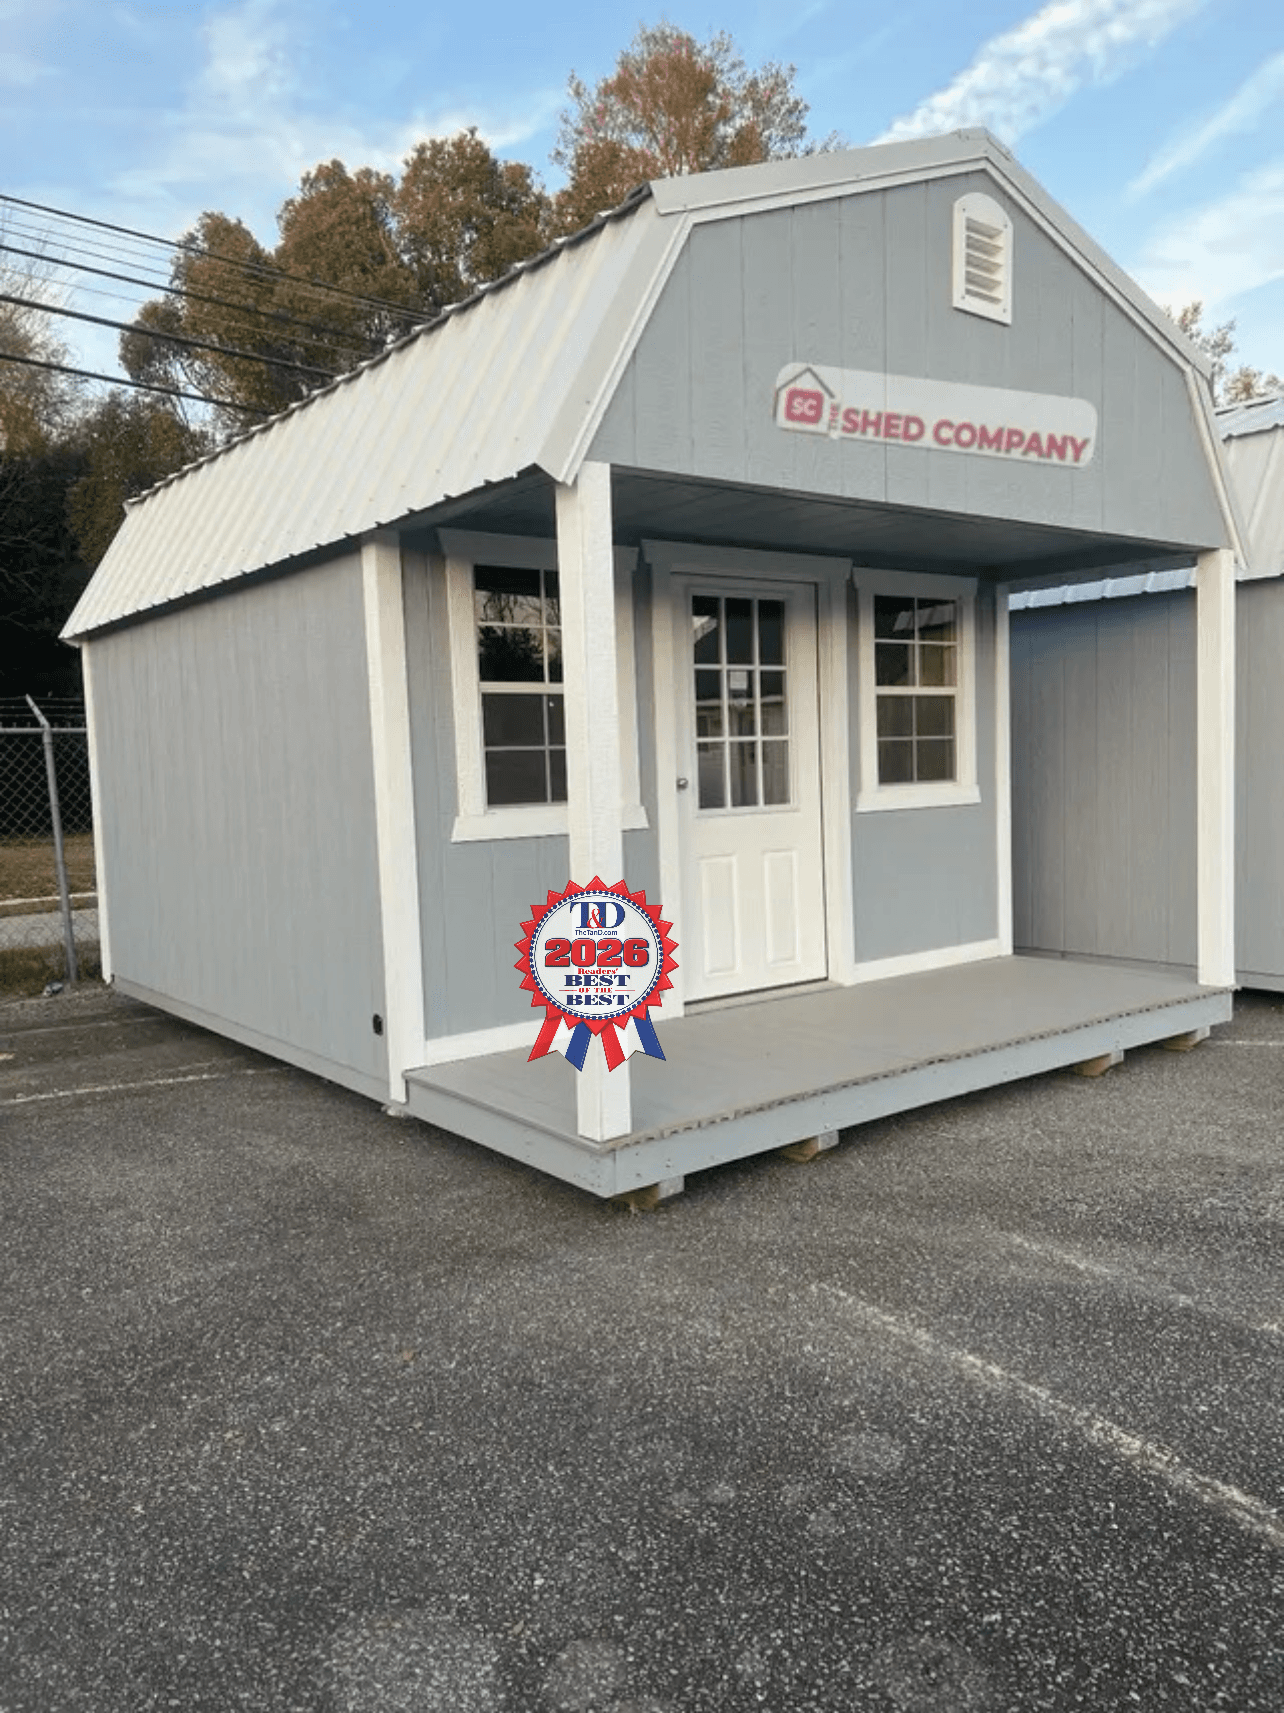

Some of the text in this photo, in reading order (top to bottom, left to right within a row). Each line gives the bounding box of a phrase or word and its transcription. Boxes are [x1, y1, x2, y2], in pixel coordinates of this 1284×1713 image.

[791, 396, 818, 417] SC
[842, 407, 1090, 463] SHED COMPANY
